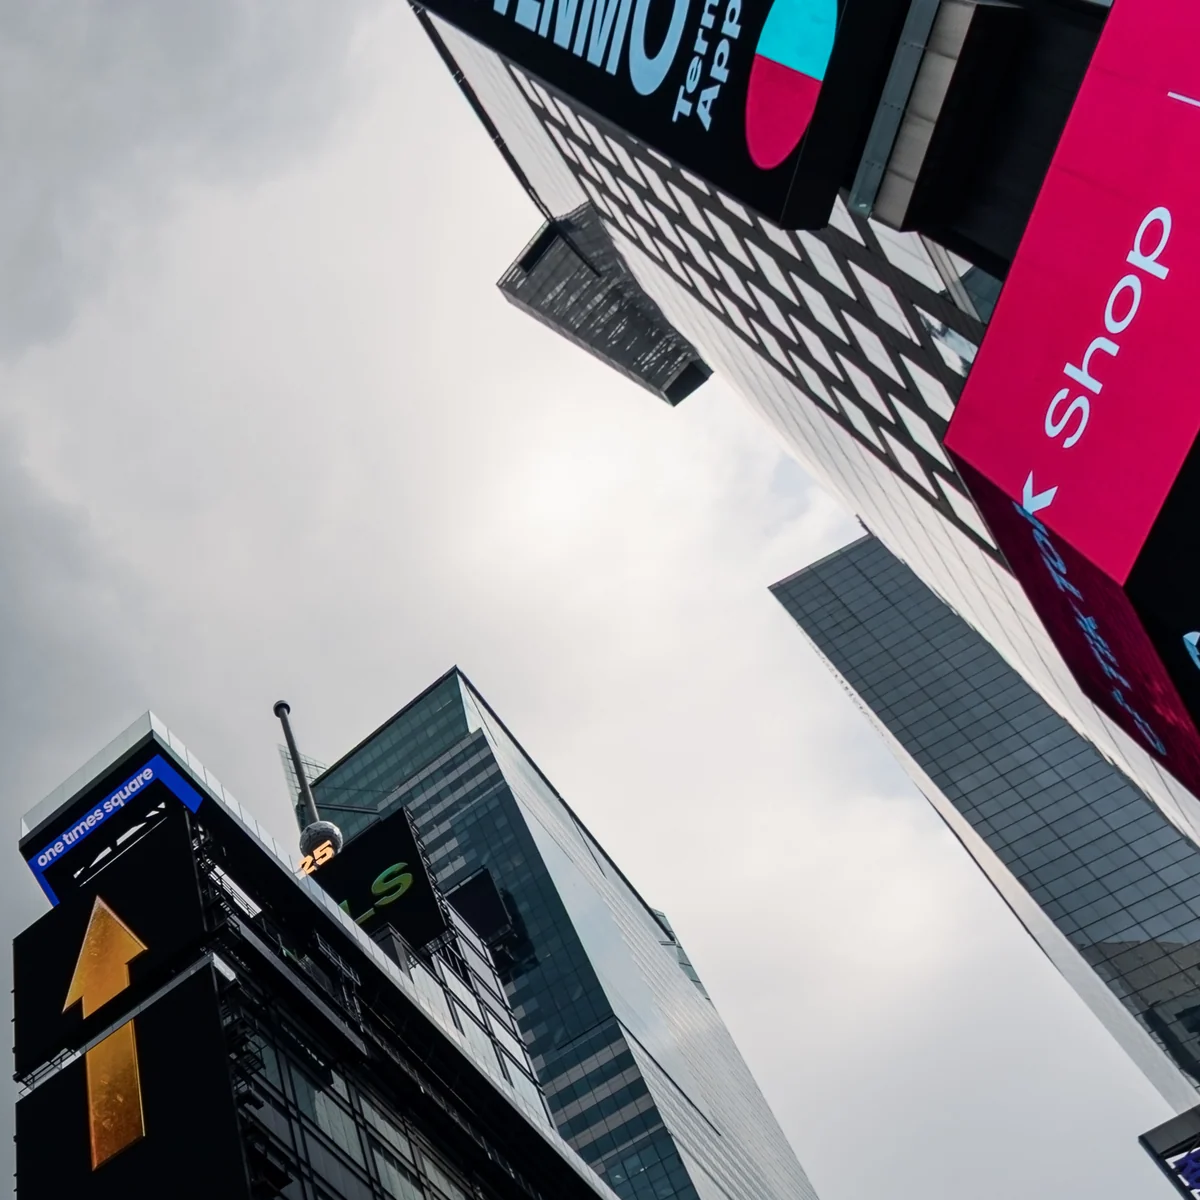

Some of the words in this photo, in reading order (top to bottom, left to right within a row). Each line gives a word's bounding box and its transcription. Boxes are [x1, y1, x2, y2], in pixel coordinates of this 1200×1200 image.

[1044, 206, 1172, 448] Shop
[37, 841, 65, 867] one
[62, 808, 104, 845] times
[103, 768, 154, 807] square
